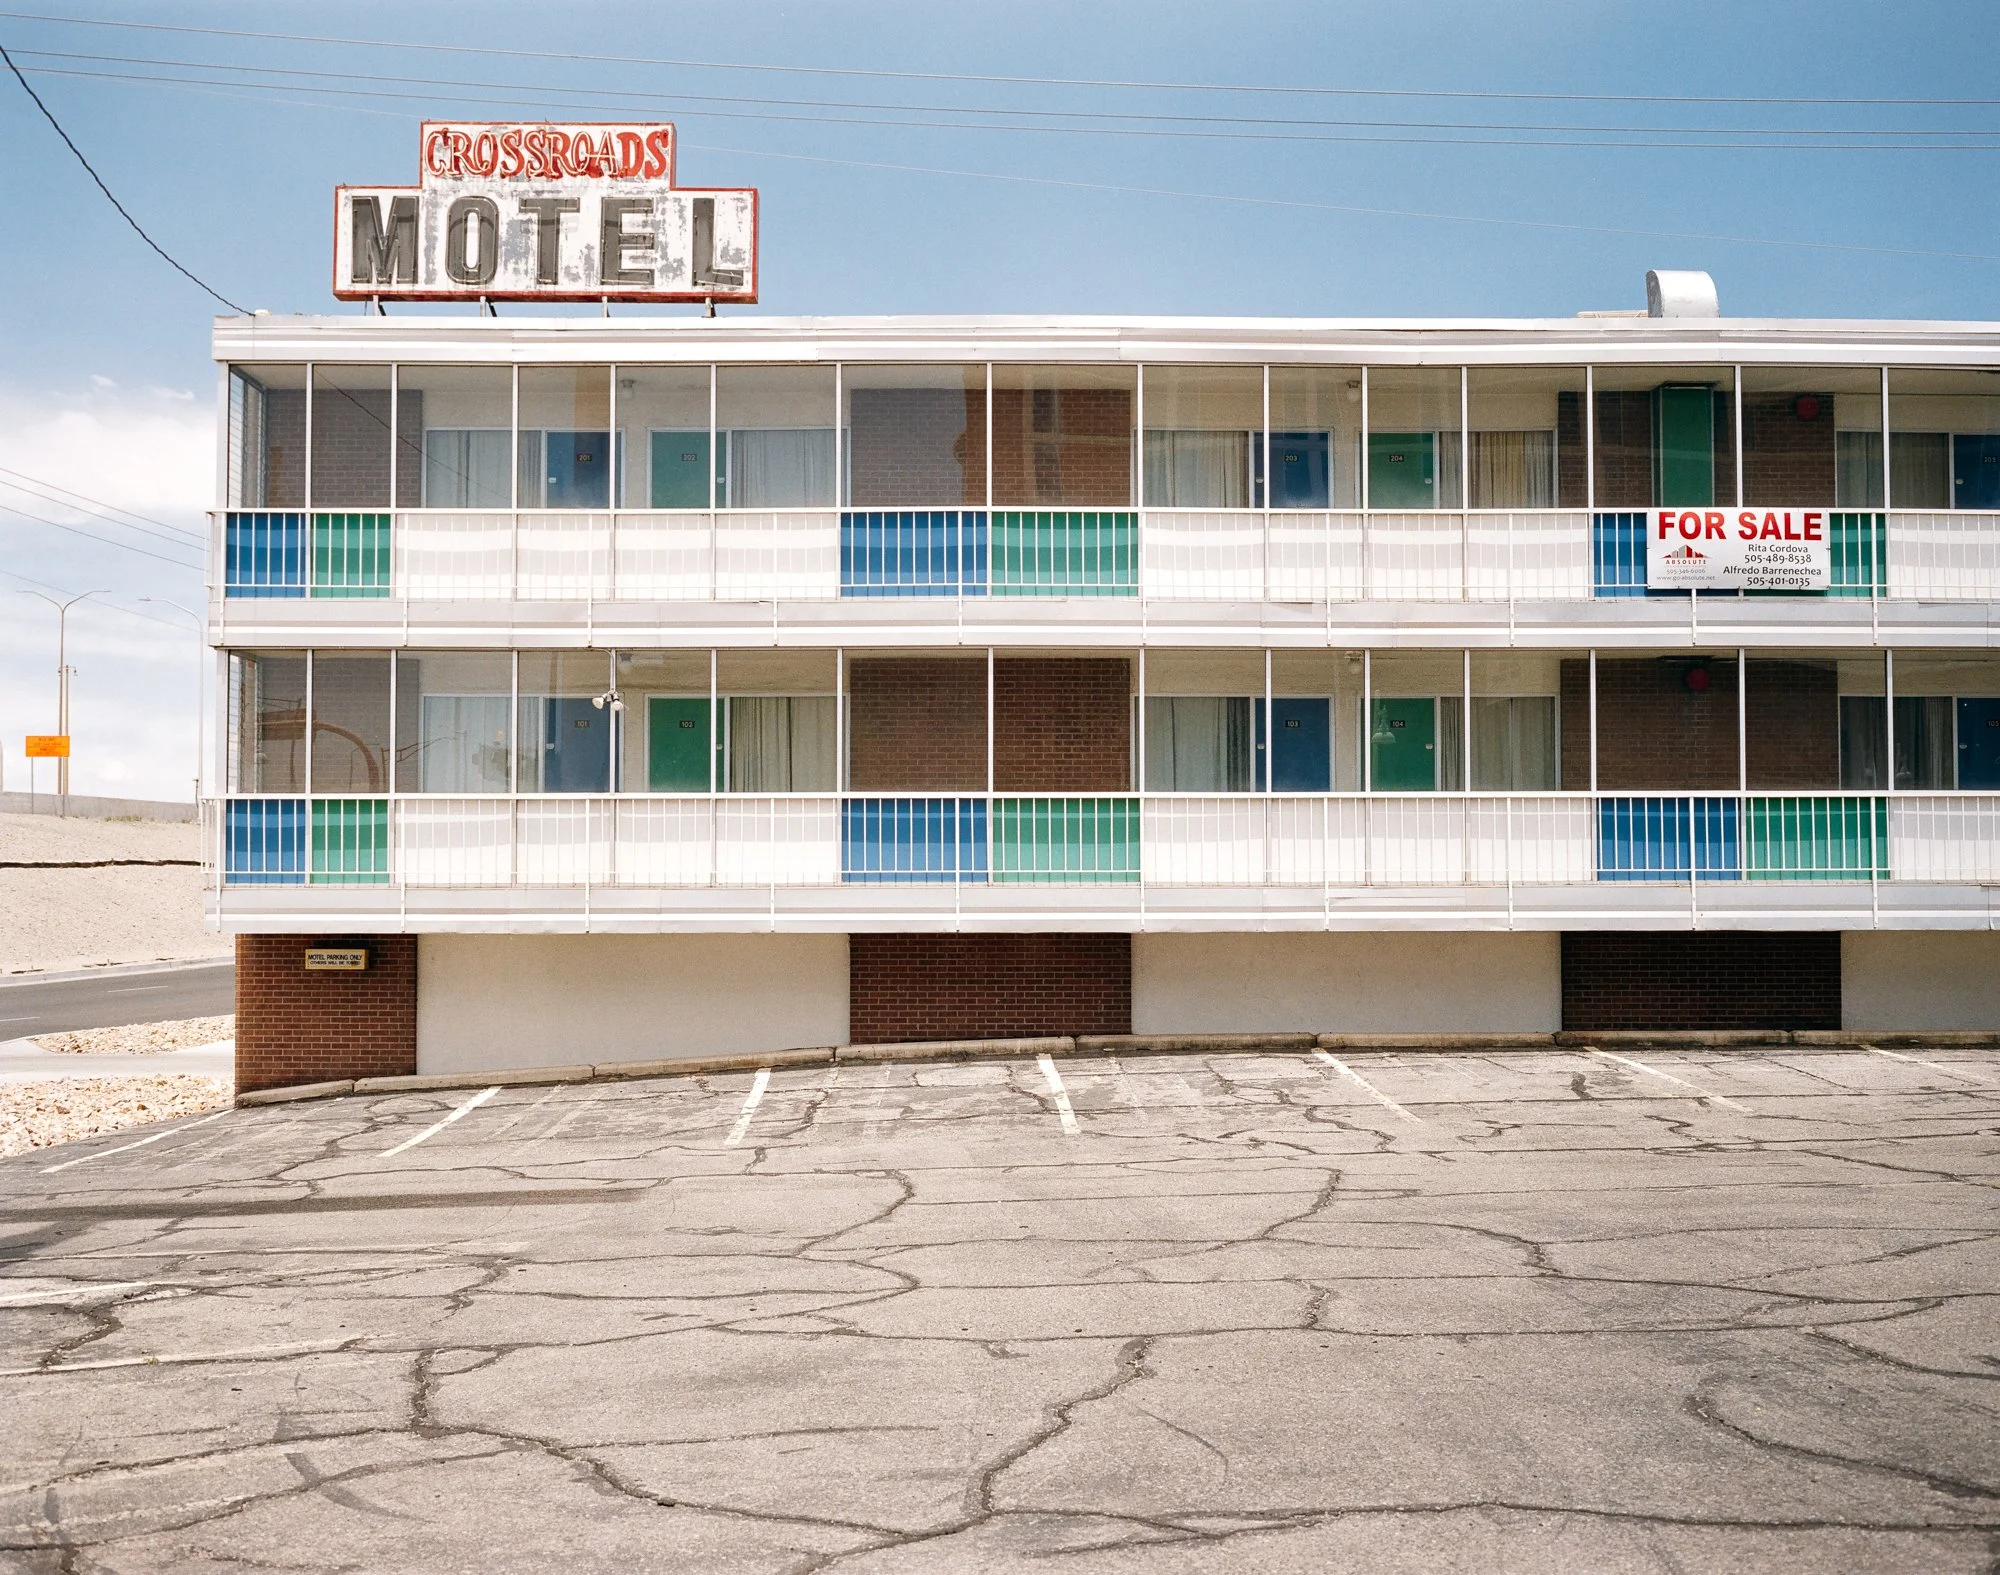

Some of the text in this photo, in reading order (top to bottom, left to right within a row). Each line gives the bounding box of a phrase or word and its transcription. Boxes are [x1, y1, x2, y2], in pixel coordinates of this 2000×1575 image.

[424, 128, 669, 180] CROSSROADS
[351, 195, 744, 287] MOTEL
[1658, 511, 1822, 541] FOR SALE
[1748, 543, 1808, 553] Rita Cordova
[1744, 553, 1812, 564] 505-489-8538
[1723, 566, 1822, 576] Alfredo Barrenechea
[1747, 576, 1811, 587] 505-401-0135
[577, 720, 588, 728] 101
